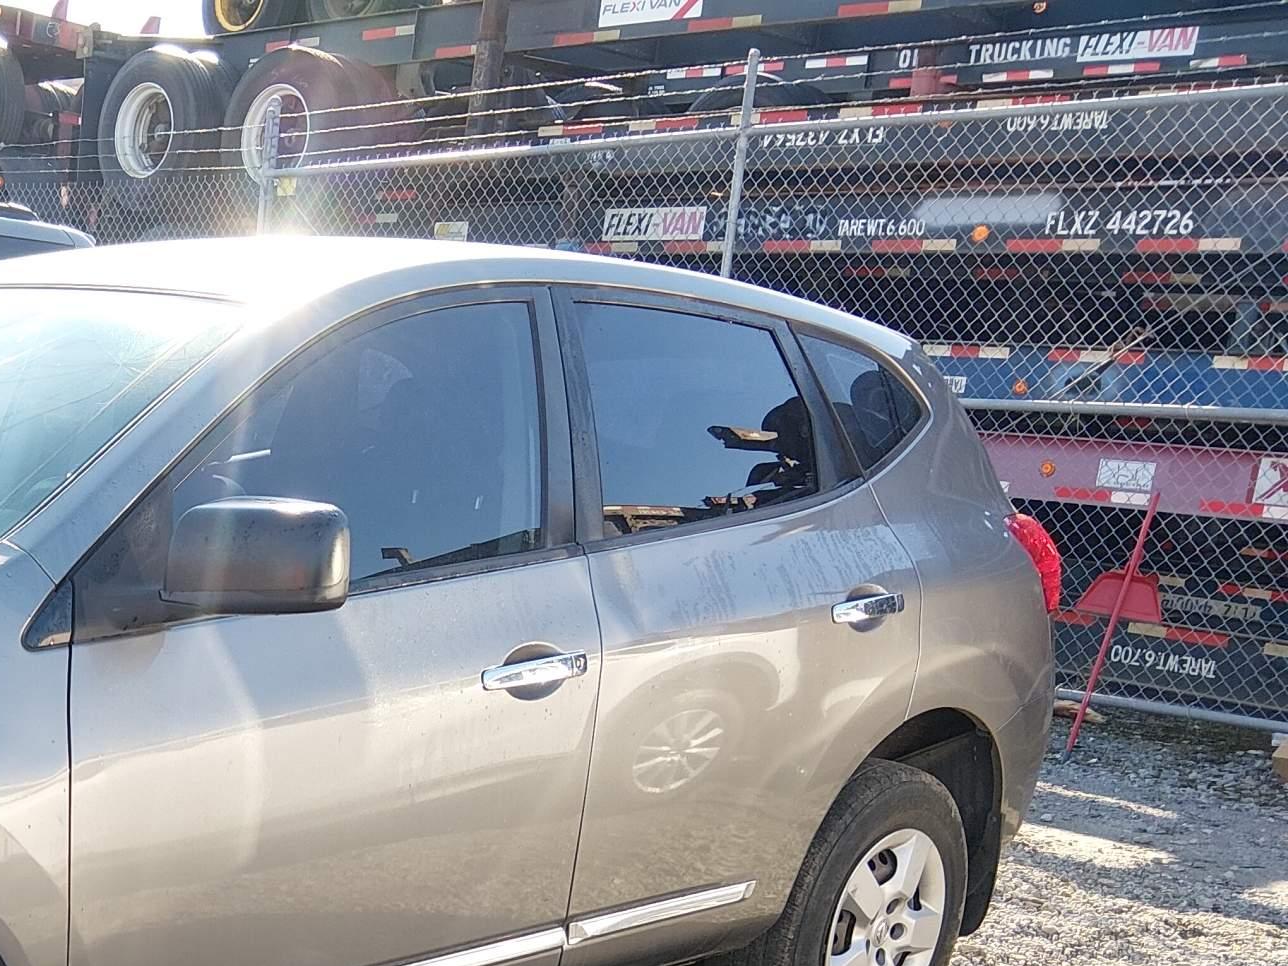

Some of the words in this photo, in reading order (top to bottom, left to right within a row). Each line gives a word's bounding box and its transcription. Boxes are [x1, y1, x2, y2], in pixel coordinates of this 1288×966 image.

[602, 0, 645, 15] FLEXI
[969, 37, 1070, 64] TRUCKING
[604, 211, 704, 236] FLEXI-VAN
[1045, 210, 1100, 235] FLXZ
[1106, 209, 1194, 235] 442726
